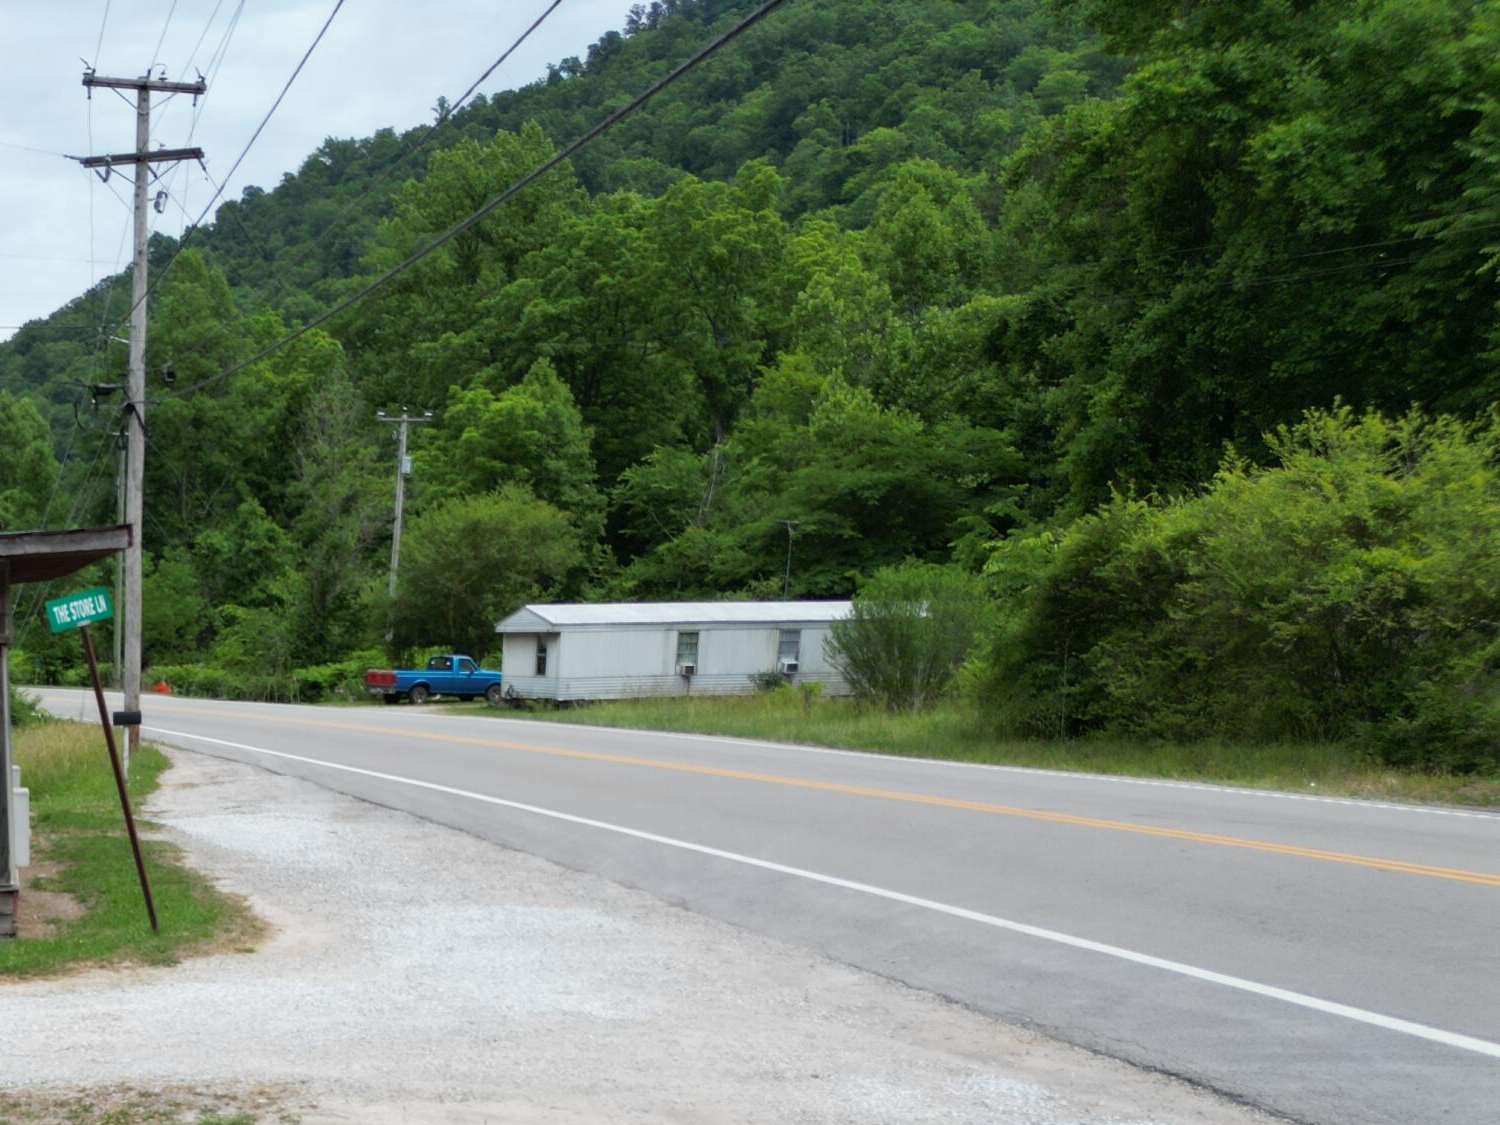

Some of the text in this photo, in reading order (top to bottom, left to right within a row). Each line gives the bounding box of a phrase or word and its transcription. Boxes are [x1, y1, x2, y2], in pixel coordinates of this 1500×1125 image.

[52, 594, 107, 625] THE STORE LN
